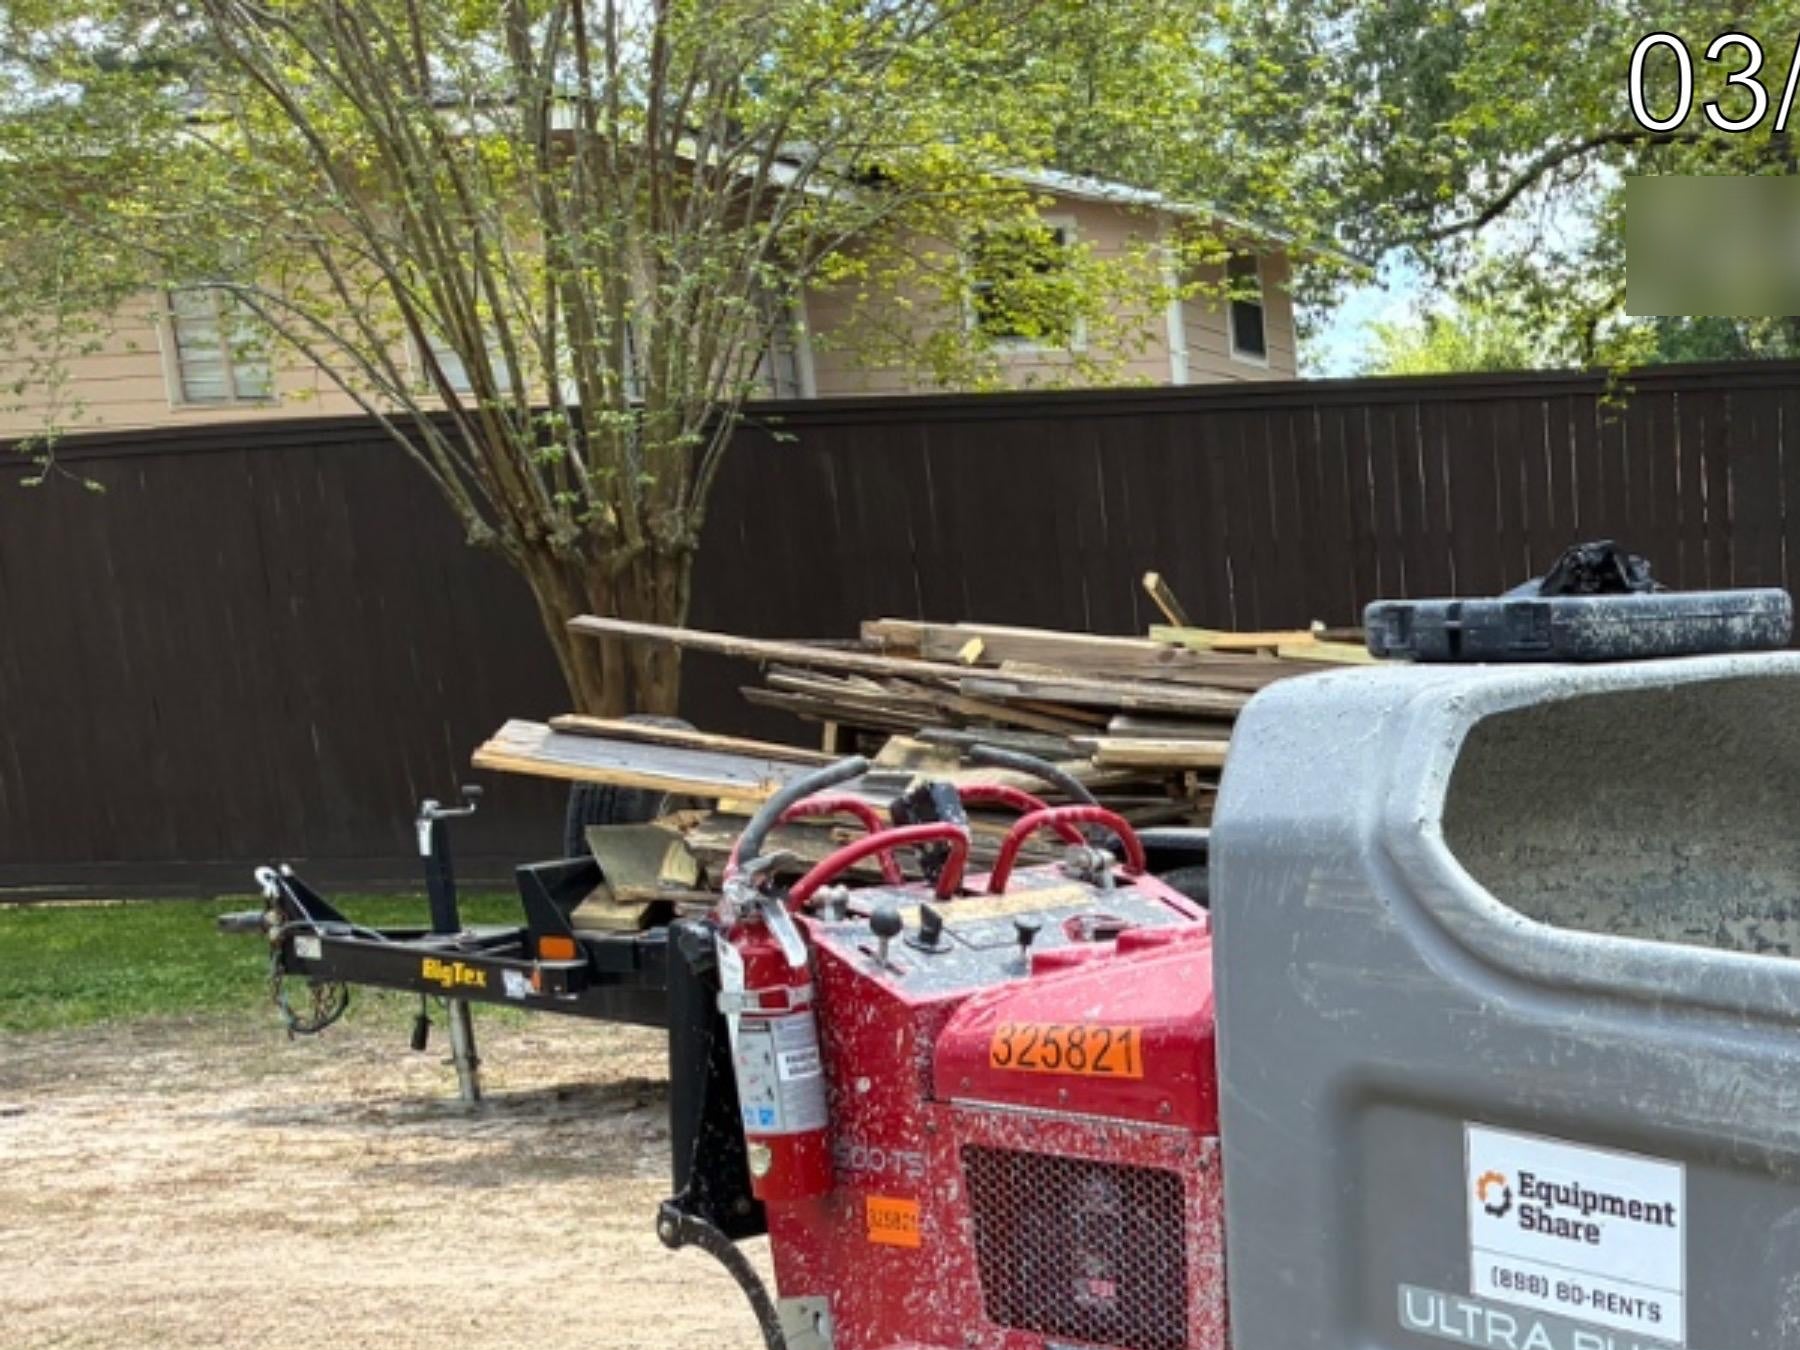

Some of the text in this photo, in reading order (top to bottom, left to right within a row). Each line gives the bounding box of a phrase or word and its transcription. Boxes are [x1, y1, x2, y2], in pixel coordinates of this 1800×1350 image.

[992, 1023, 1132, 1074] 325821
[1517, 1169, 1677, 1228] Equipment
[1518, 1203, 1601, 1245] Share
[1491, 1265, 1549, 1298] (888)
